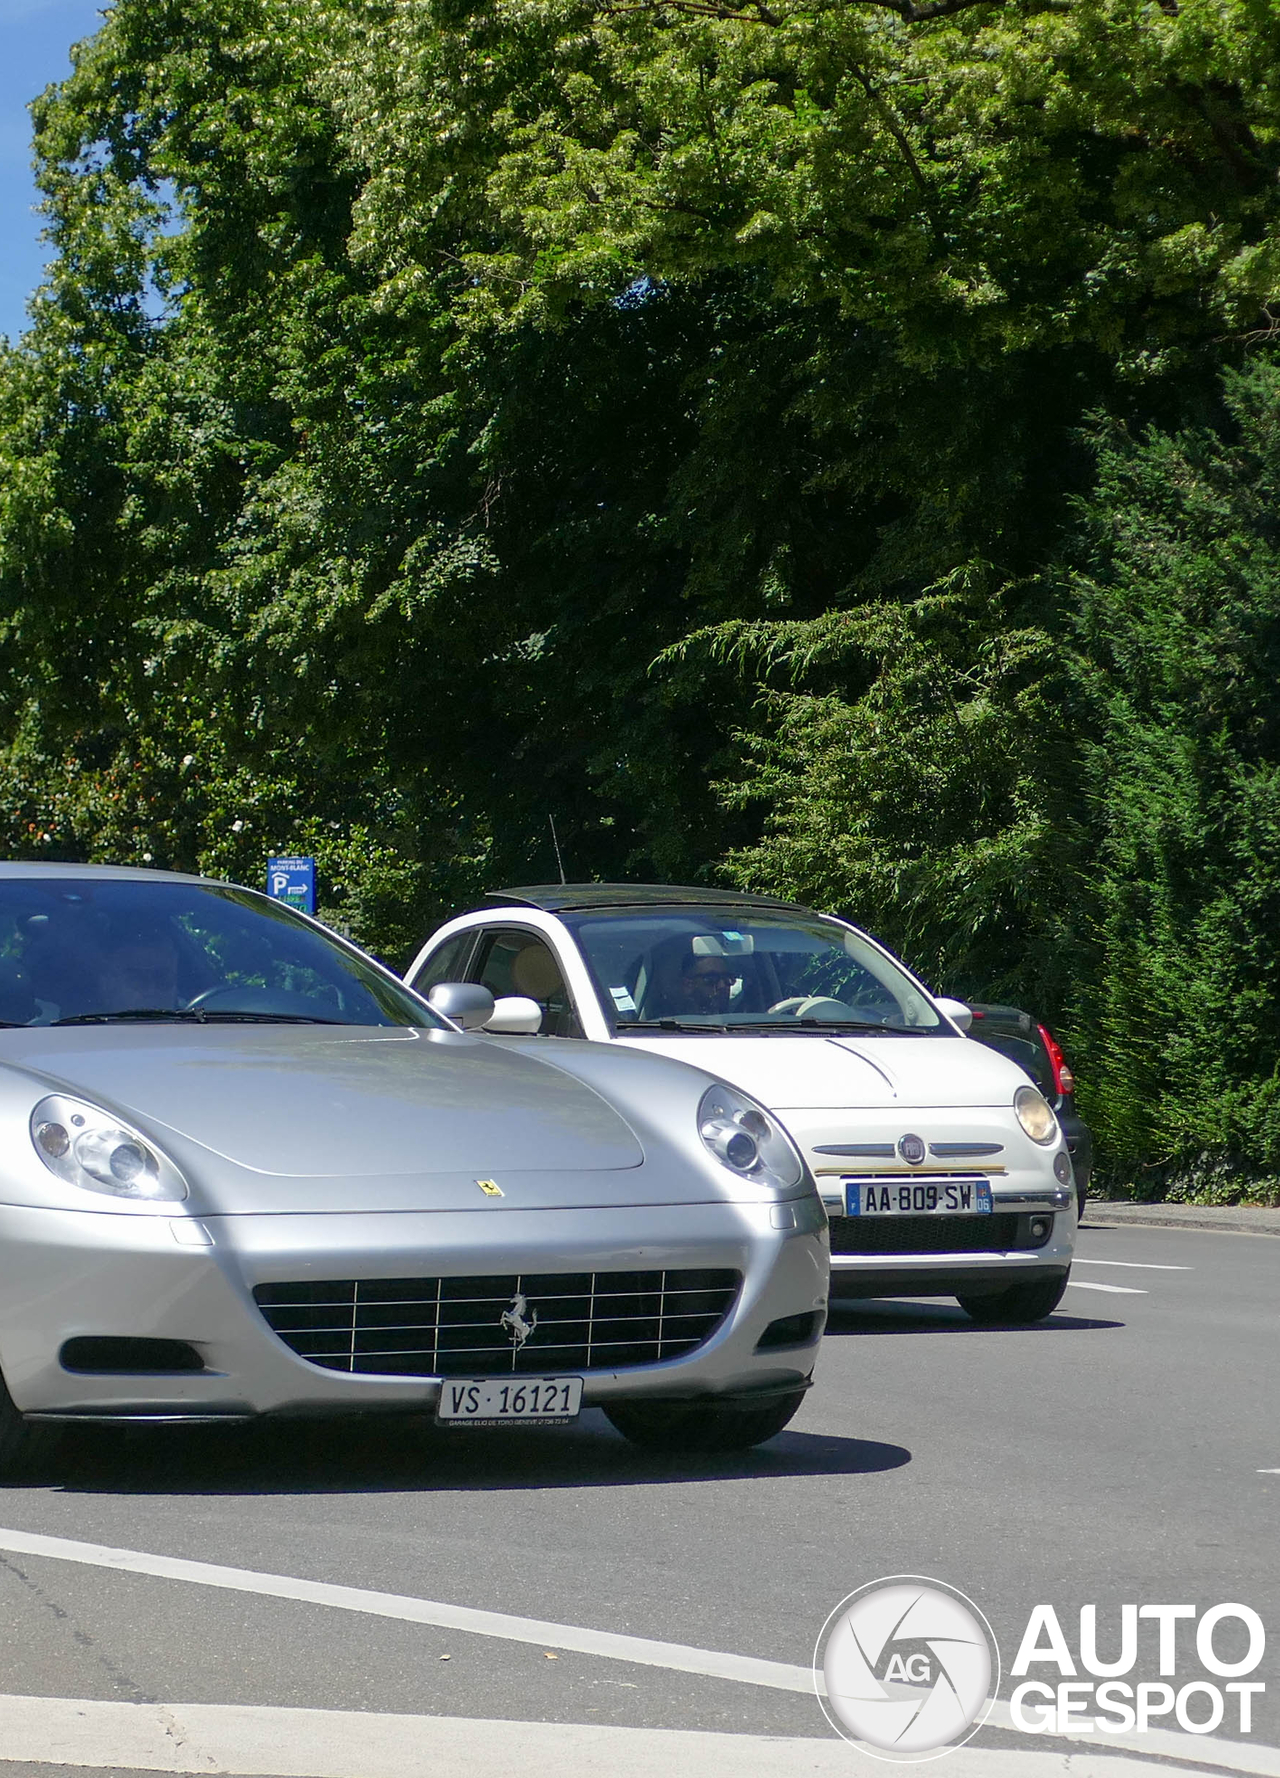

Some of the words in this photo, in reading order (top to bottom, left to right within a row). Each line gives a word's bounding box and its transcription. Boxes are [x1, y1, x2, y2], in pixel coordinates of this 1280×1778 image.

[274, 877, 287, 895] P
[866, 1185, 972, 1212] AA-809-SW
[977, 1199, 990, 1211] 06
[499, 1385, 570, 1413] 16121
